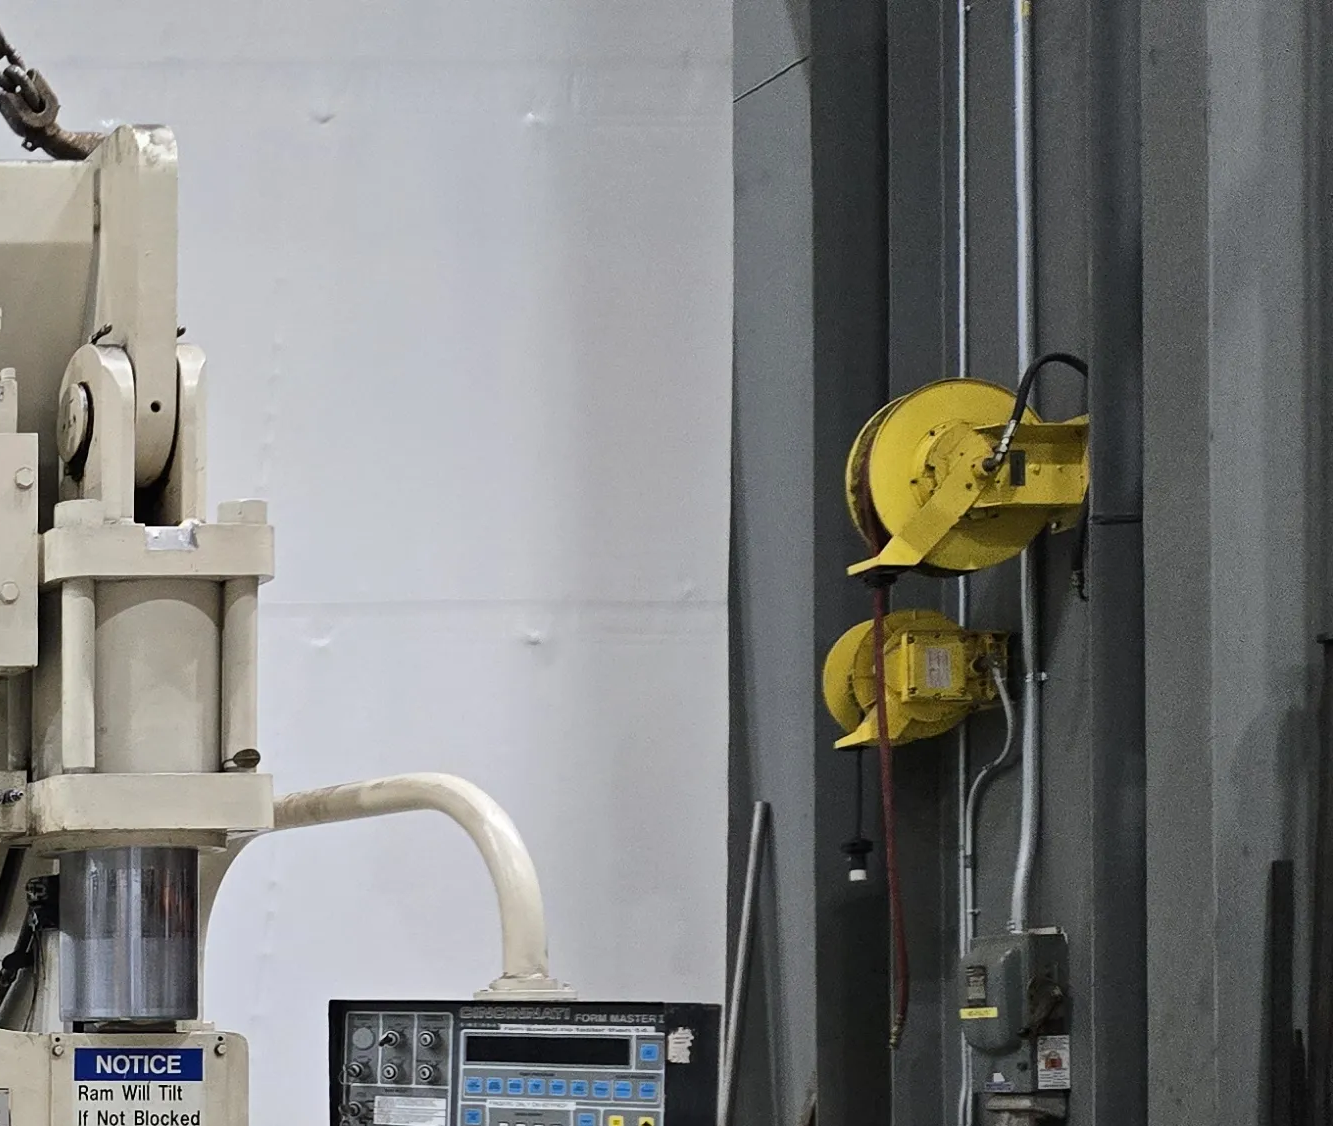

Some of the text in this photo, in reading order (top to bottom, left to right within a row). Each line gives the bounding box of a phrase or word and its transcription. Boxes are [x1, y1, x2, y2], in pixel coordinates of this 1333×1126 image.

[459, 1006, 572, 1021] CINCINNATI
[575, 1013, 607, 1023] FORM
[610, 1014, 657, 1024] MASTER
[95, 1055, 182, 1075] NOTICE
[77, 1083, 183, 1102] Ram Will Tilt
[77, 1109, 201, 1126] If Not Blocked
